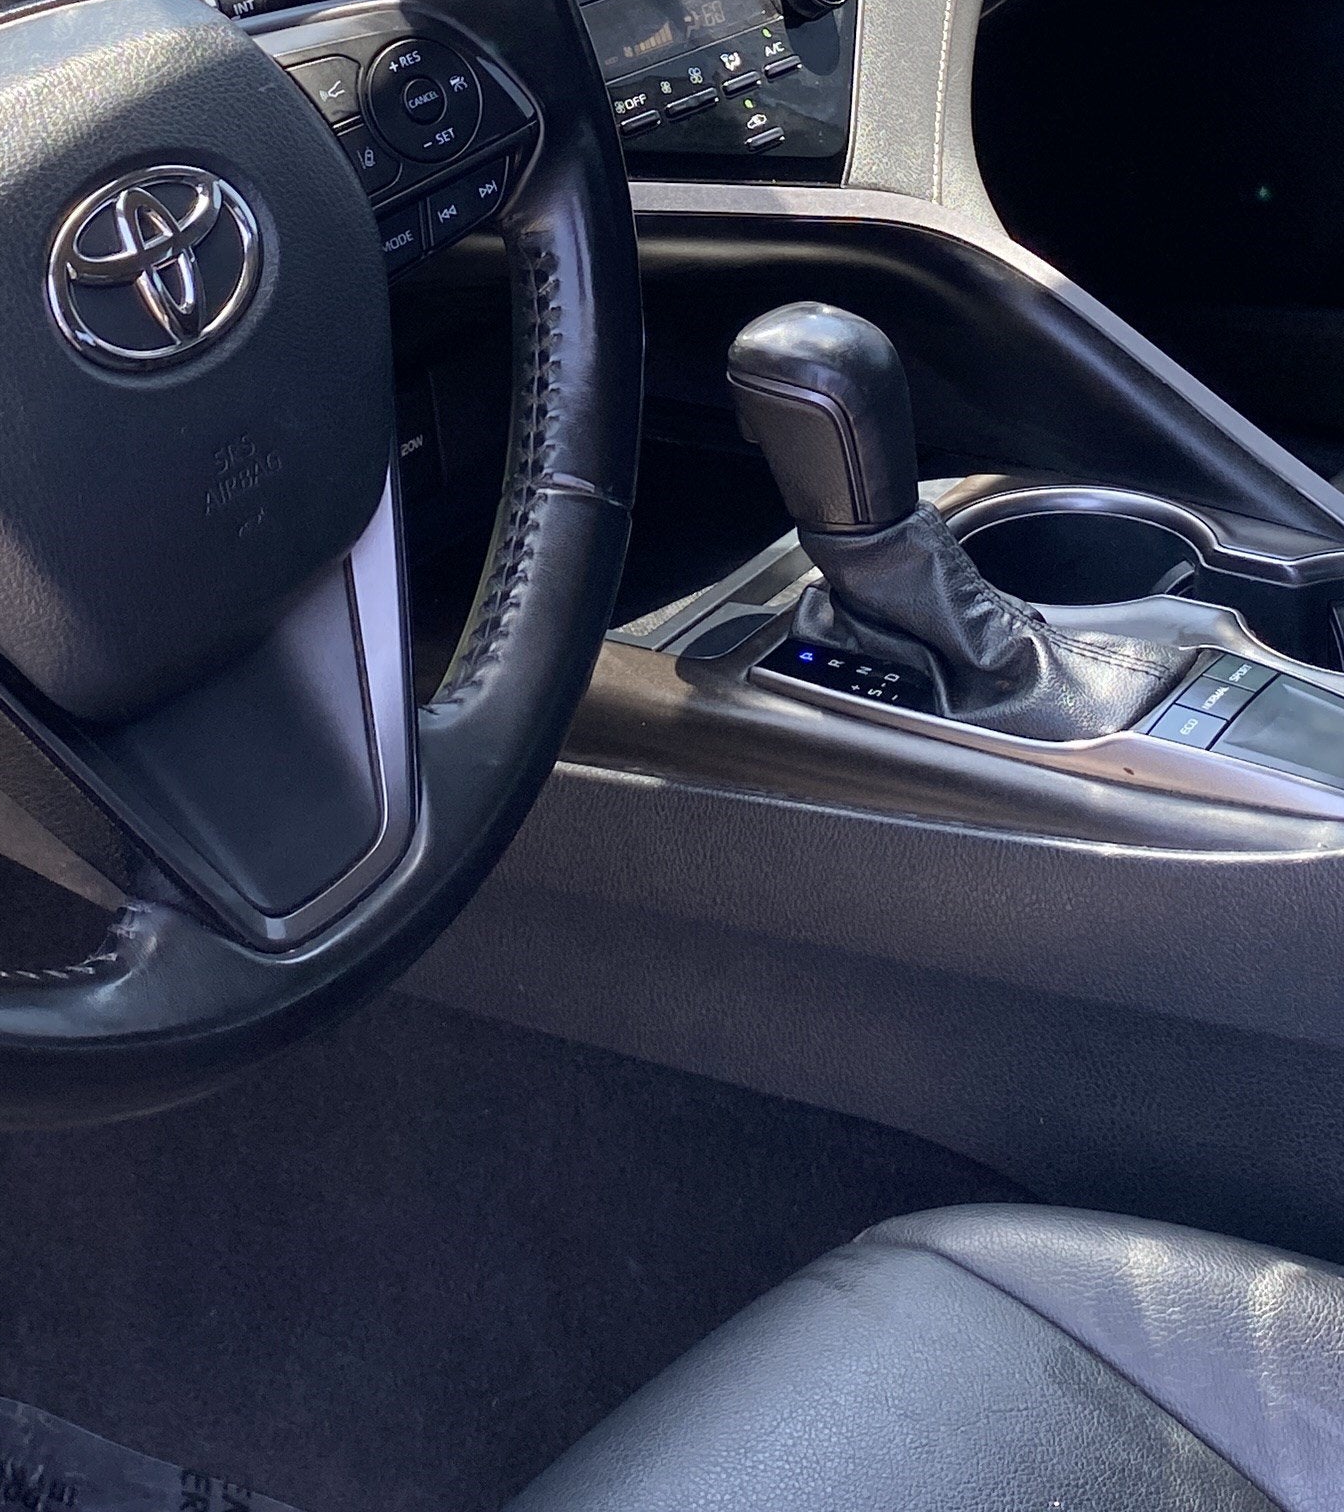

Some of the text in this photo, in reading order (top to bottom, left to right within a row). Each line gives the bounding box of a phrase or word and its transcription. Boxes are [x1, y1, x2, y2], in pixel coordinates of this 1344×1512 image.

[764, 41, 785, 58] A/C
[408, 90, 439, 110] CANCEL
[624, 93, 647, 112] OFF
[799, 651, 813, 662] P
[828, 659, 845, 668] R
[884, 673, 900, 682] D
[1228, 663, 1253, 683] SPORT
[1202, 686, 1230, 710] NORMAL
[1180, 718, 1199, 735] ECO
